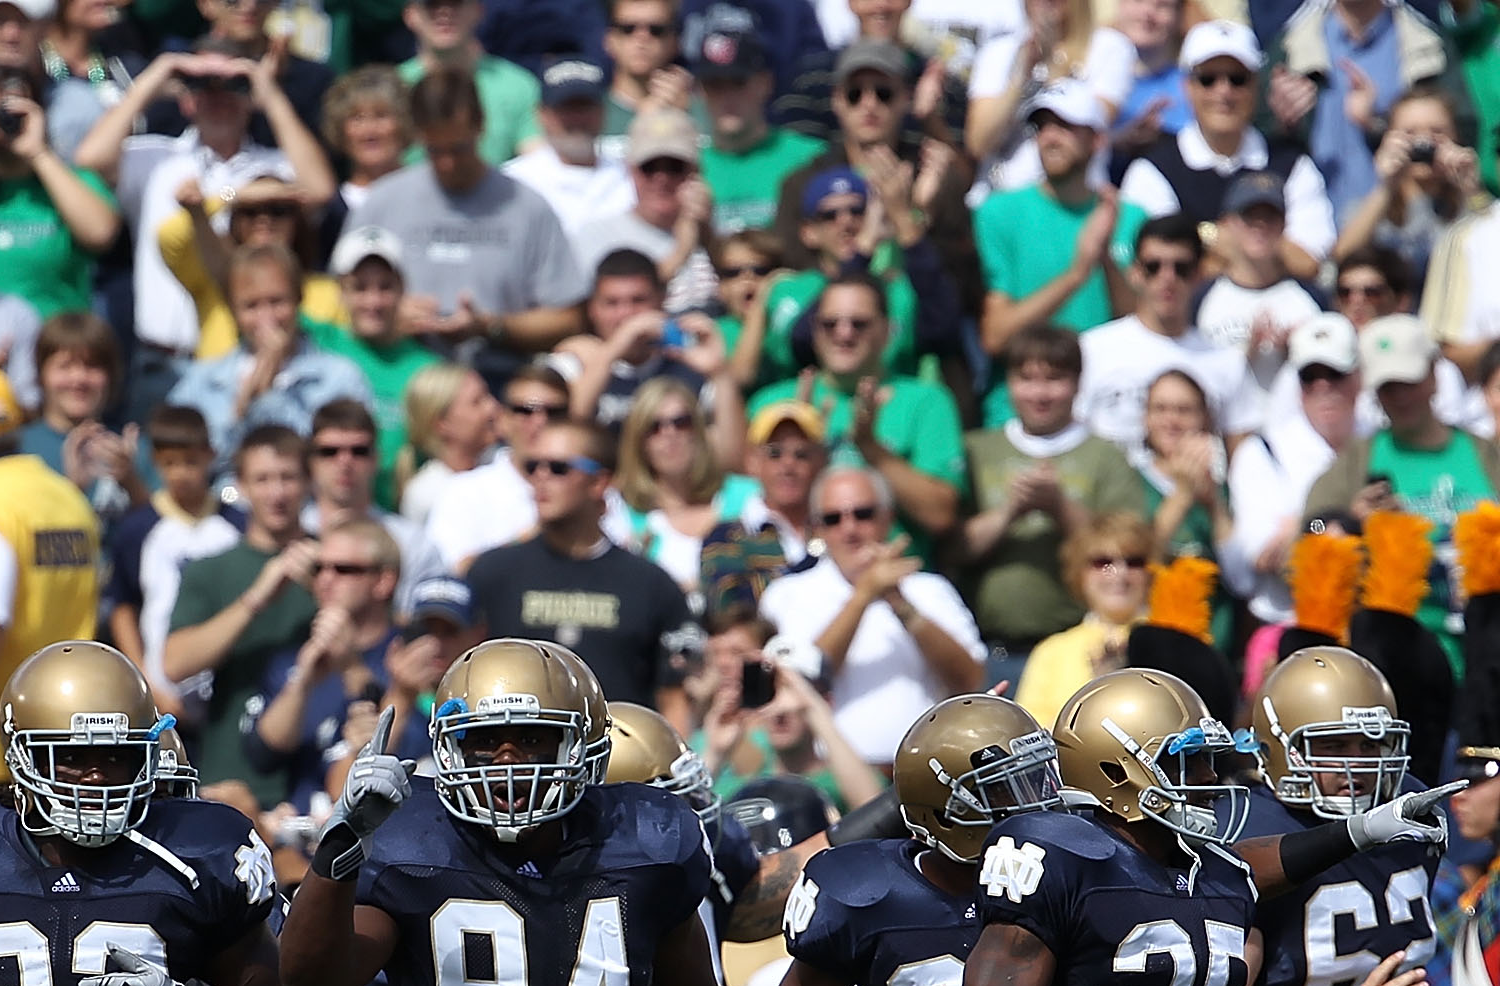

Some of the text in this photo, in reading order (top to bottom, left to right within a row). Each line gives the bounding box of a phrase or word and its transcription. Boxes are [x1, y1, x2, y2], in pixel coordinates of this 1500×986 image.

[493, 696, 522, 705] IRISH
[86, 717, 114, 725] IRISH
[51, 883, 80, 892] adidas
